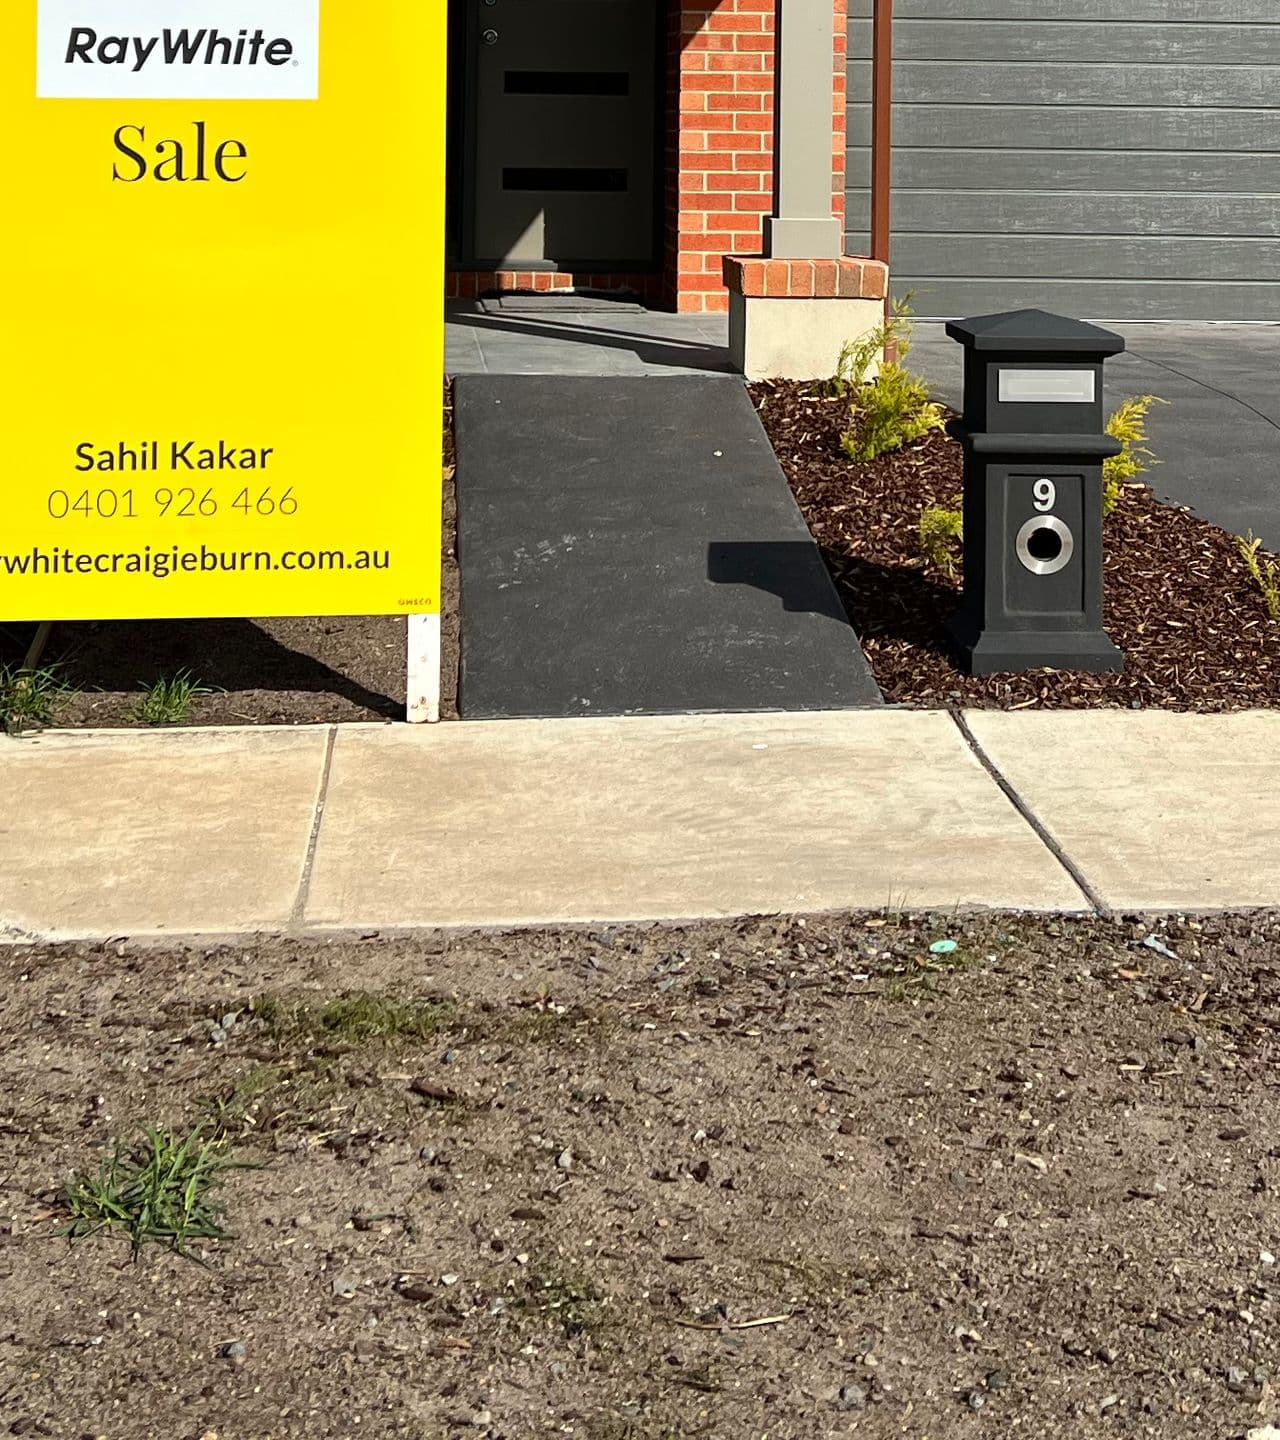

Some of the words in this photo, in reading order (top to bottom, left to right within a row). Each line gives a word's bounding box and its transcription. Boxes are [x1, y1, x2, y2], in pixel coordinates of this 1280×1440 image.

[112, 121, 248, 182] Sale
[75, 440, 158, 472] Sahil
[171, 440, 274, 470] Kakar
[47, 488, 139, 519] 0401
[154, 487, 218, 517] 926
[230, 486, 299, 516] 466
[1033, 478, 1057, 512] 9
